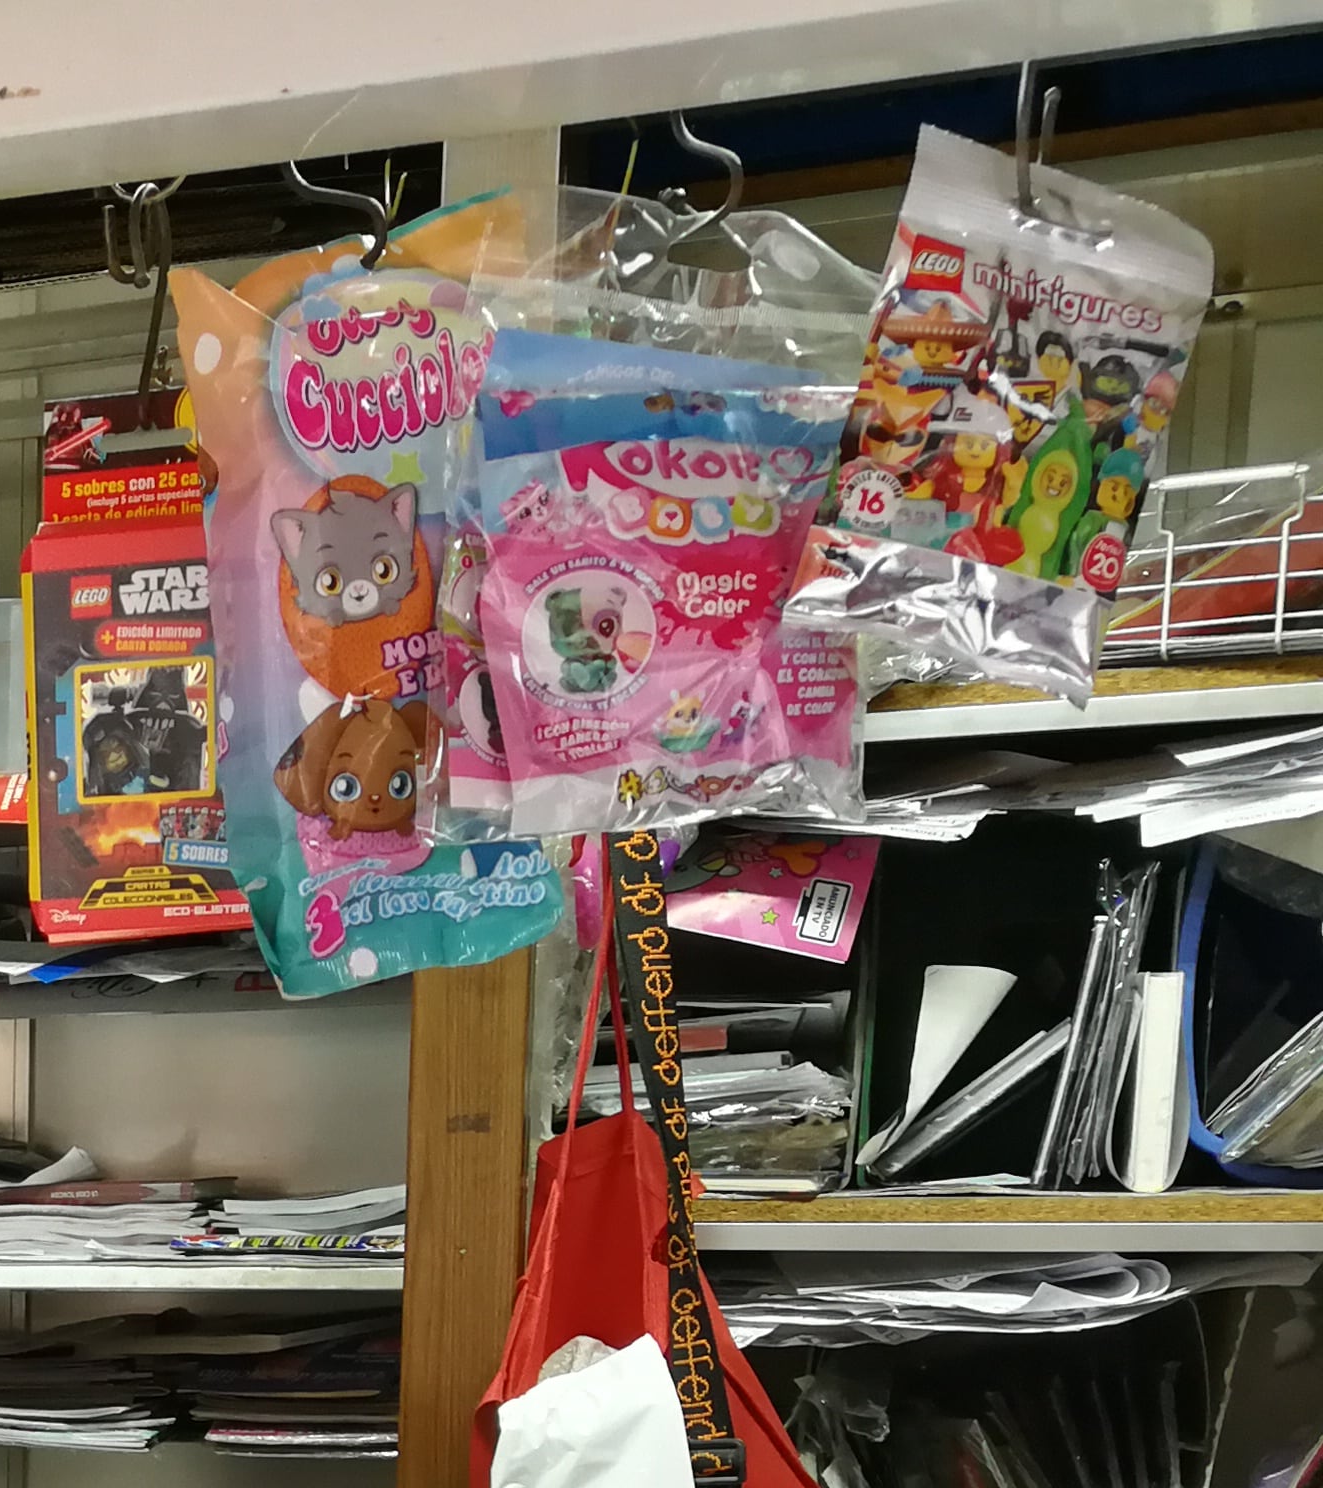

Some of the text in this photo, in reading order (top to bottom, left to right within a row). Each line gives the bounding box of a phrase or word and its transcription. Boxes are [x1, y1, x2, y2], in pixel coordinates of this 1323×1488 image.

[915, 250, 1162, 333] LEGO minifigures
[61, 472, 177, 498] 5 sobres con 25
[859, 488, 885, 514] 16
[1089, 556, 1119, 579] 20
[73, 565, 208, 606] LEGO STAR
[676, 570, 757, 594] Magic
[121, 590, 209, 616] WARS
[685, 596, 750, 619] Color
[49, 908, 86, 924] Disney
[819, 886, 840, 938] ANUNCIADO
